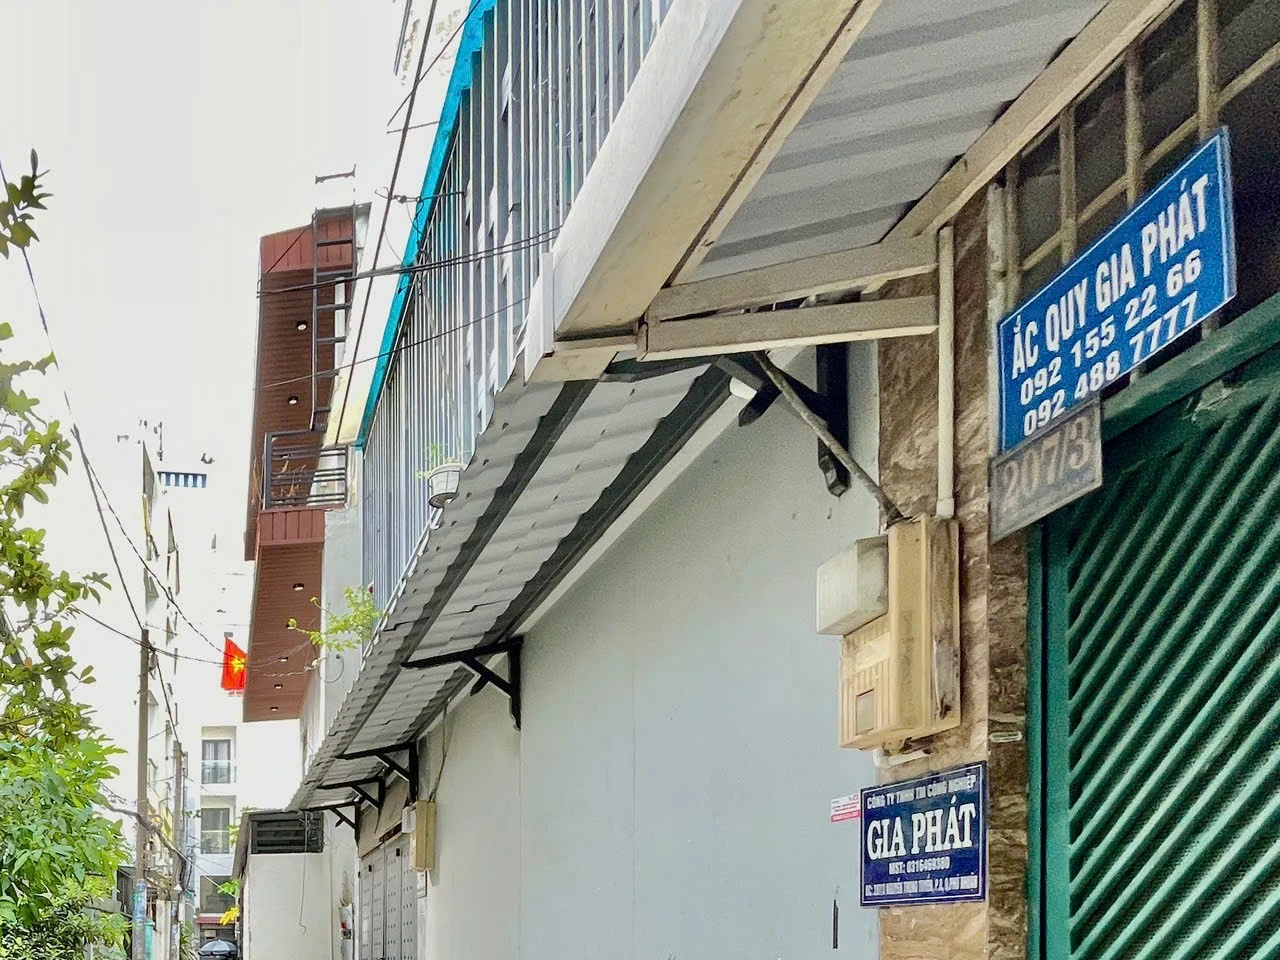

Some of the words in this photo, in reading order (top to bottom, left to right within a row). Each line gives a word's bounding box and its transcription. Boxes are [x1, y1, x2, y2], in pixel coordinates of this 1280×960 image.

[1011, 315, 1038, 380] ẮC
[1045, 278, 1088, 353] QUY
[1095, 243, 1137, 313] GIA
[1141, 172, 1209, 279] PHÁT
[1019, 356, 1062, 406] 092
[1071, 320, 1115, 364] 155
[1124, 285, 1158, 333] 22
[1167, 248, 1202, 295] 66
[1023, 389, 1066, 437] 092
[1073, 350, 1121, 401] 488
[1129, 291, 1199, 363] 7777
[866, 816, 907, 861] GIA
[910, 795, 977, 855] PHÁT
